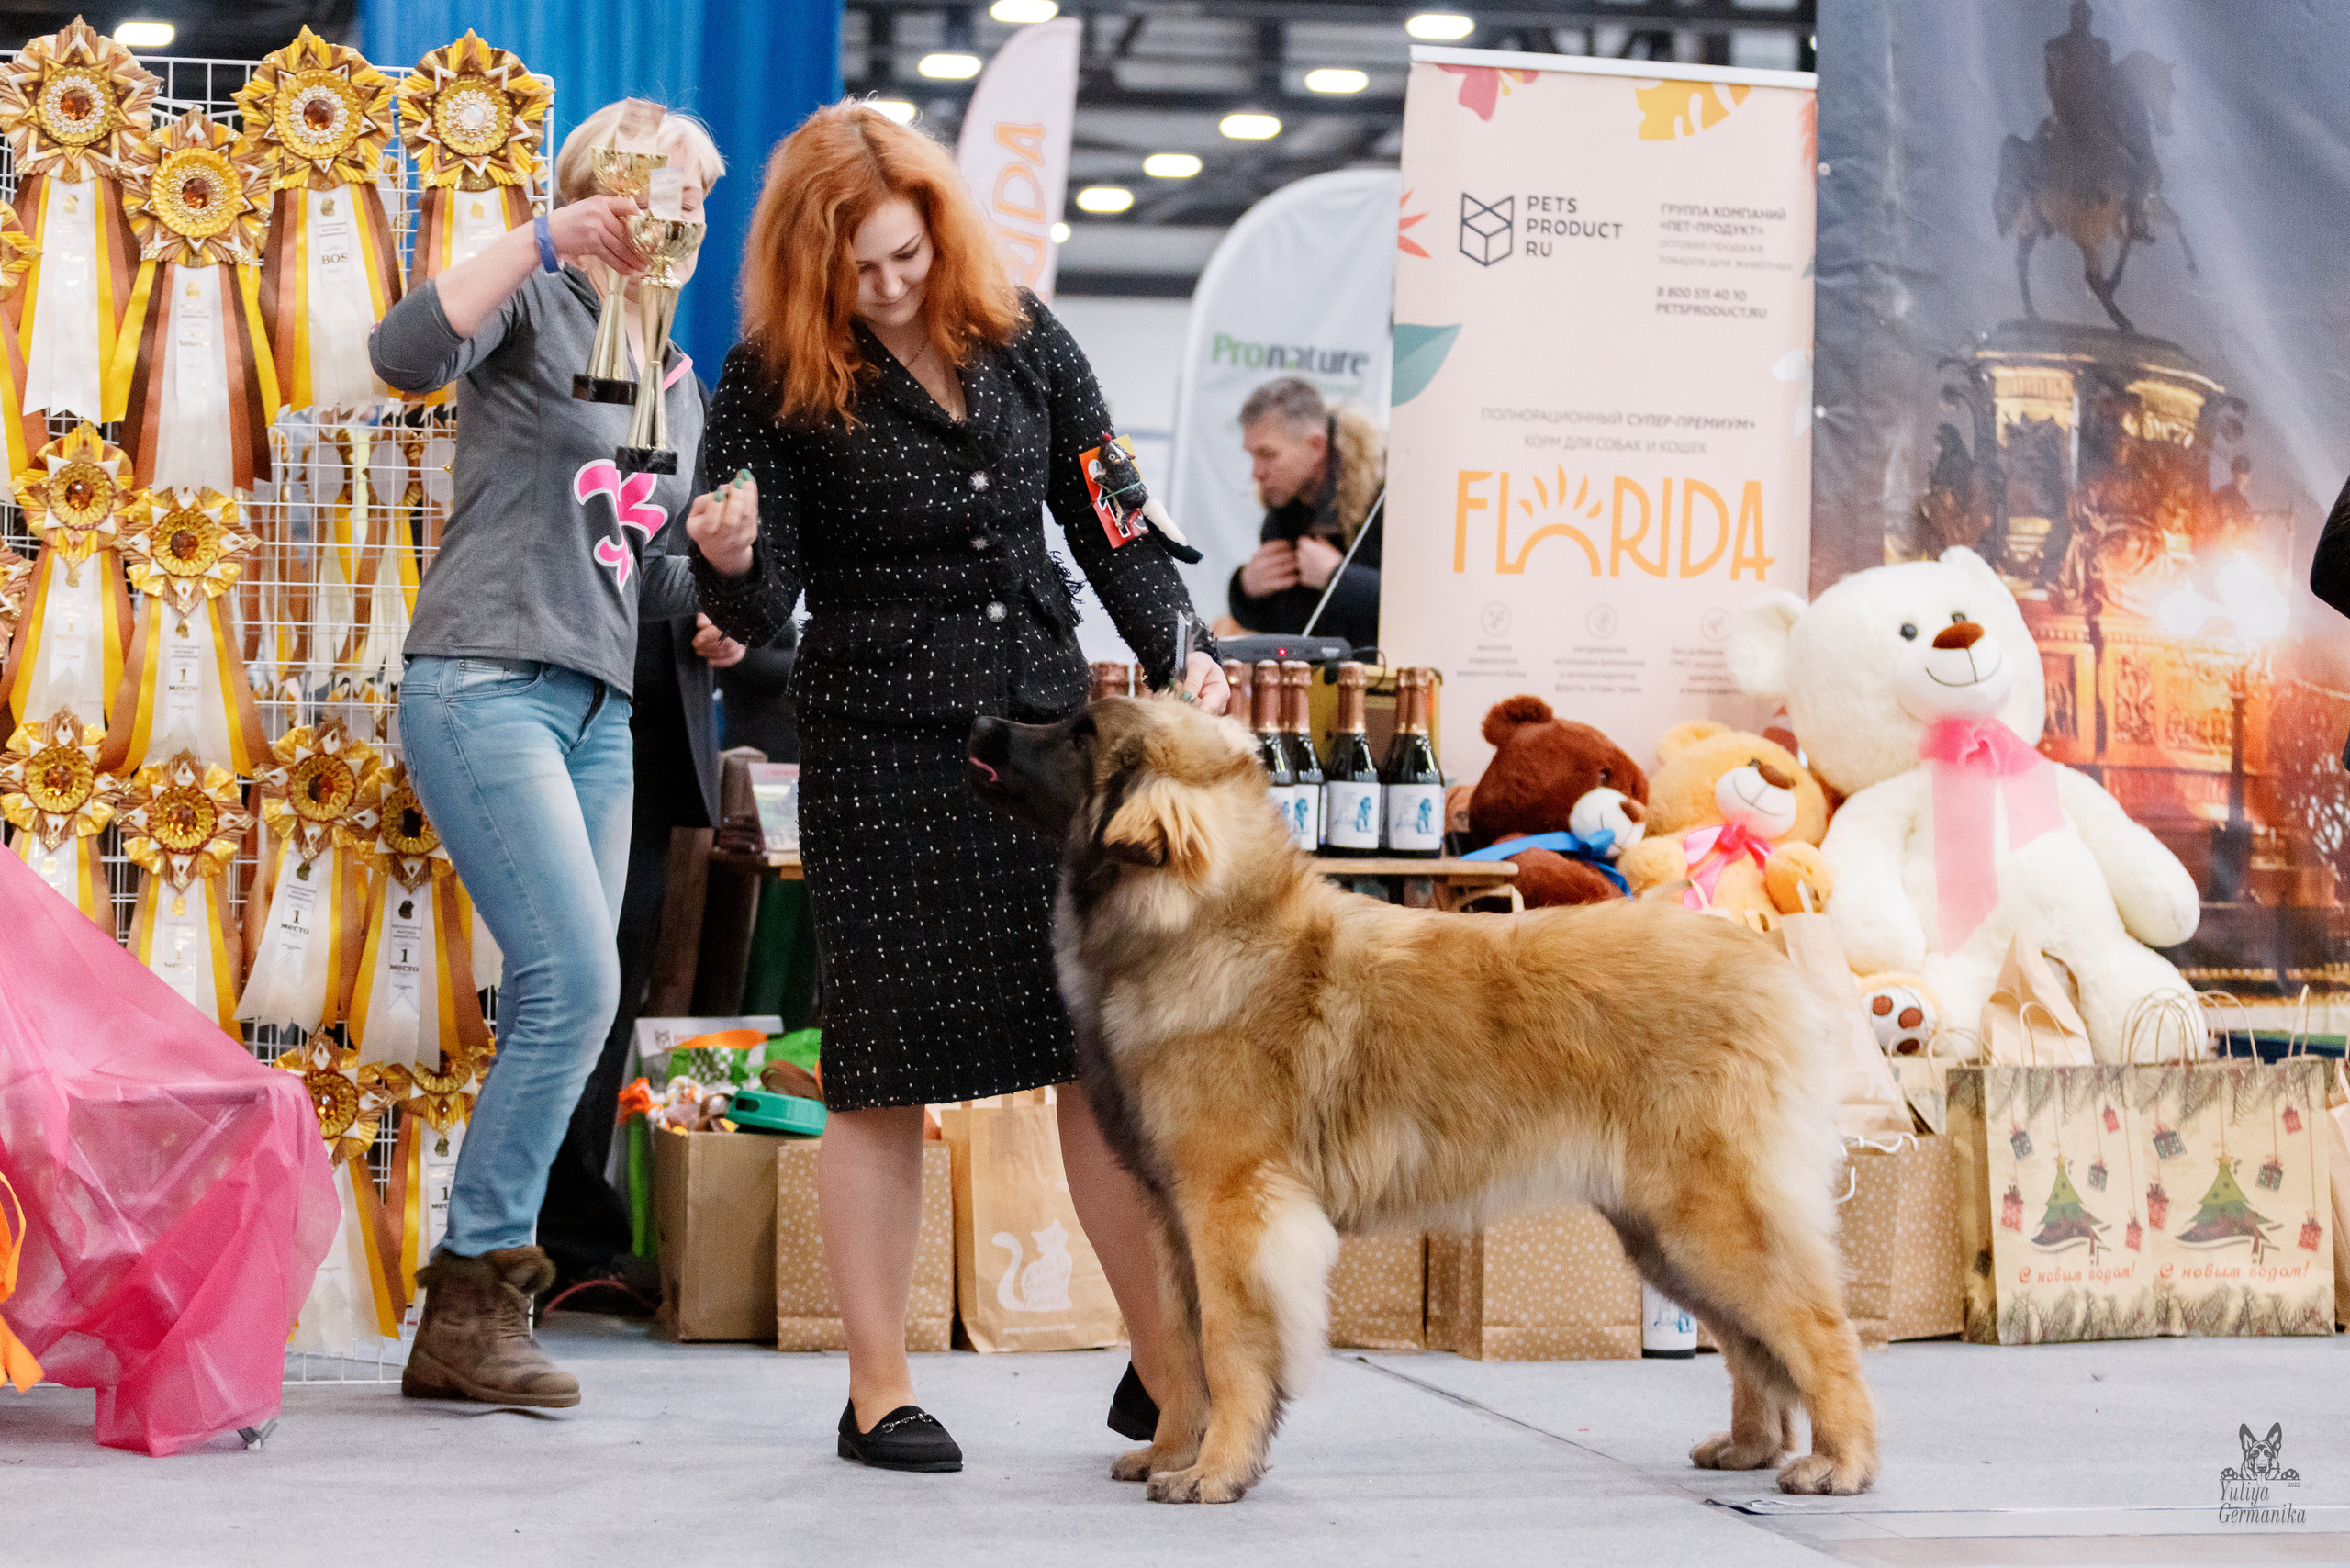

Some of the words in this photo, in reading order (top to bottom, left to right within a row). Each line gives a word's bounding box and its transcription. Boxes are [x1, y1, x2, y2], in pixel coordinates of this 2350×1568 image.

[1528, 196, 1577, 213] PETS
[1661, 203, 1709, 216] ГРУППА
[1713, 206, 1786, 220] КОМПАНИЙ
[1527, 218, 1623, 238] PRODUCT
[1526, 241, 1552, 257] RU
[321, 252, 349, 265] BOS
[1655, 302, 1767, 319] PETSPRODUCT.RU
[1480, 406, 1623, 425] ПОЛНОРАЦИОННЫЙ
[1524, 434, 1561, 448] КОРМ
[1563, 435, 1593, 451] ДЛЯ
[1595, 436, 1642, 452] СОБАК
[1645, 439, 1657, 452] И
[1660, 439, 1708, 455] КОШЕК
[1453, 464, 1776, 581] FLORIDA
[179, 668, 188, 683] 1
[293, 910, 300, 924] 1
[401, 948, 408, 963] 1
[442, 1186, 449, 1201] 1
[2037, 1266, 2082, 1282] новым
[2182, 1263, 2240, 1278] новым
[2249, 1260, 2310, 1282] годом!
